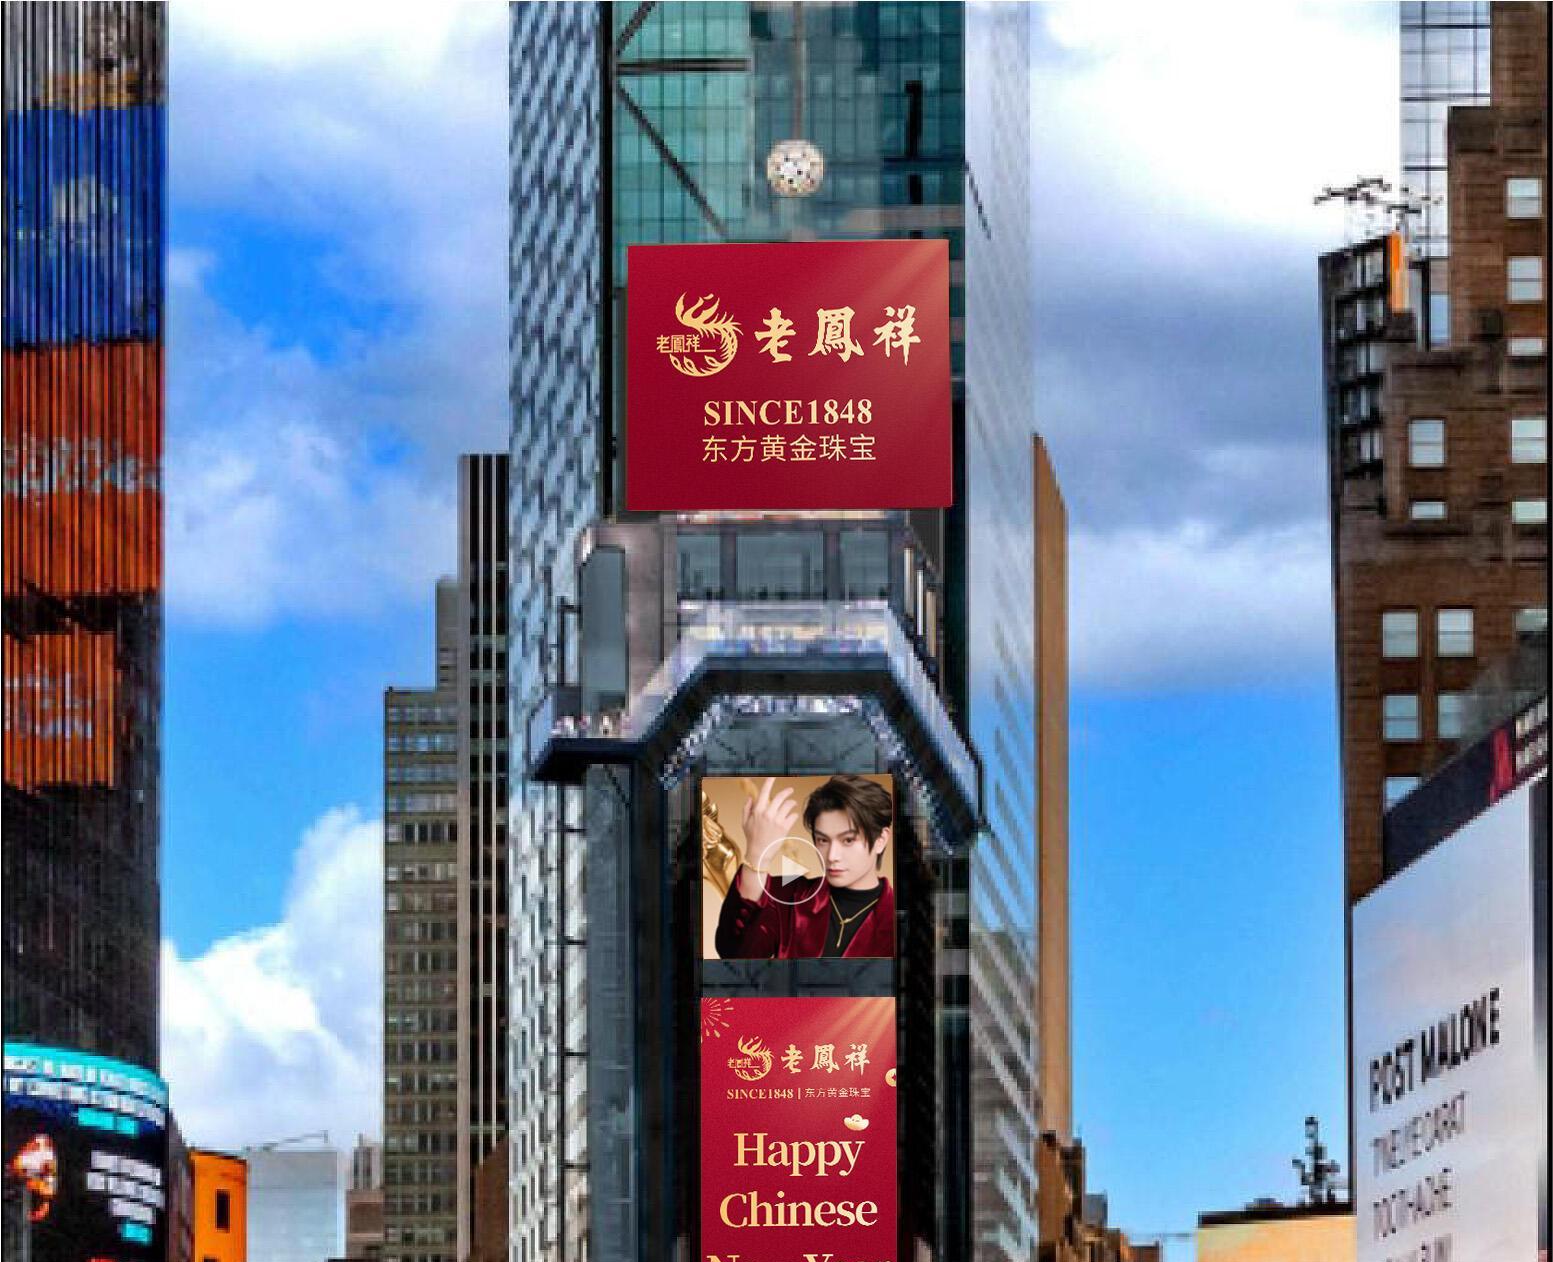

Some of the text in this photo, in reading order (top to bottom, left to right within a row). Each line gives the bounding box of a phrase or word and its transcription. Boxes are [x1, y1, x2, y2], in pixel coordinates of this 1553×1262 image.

[754, 304, 921, 366] 老鳳祥
[703, 398, 873, 426] SINCE1848
[702, 433, 876, 463] 东方黄金珠宝
[781, 1043, 871, 1076] 老鳳祥
[1369, 987, 1500, 1113] POST MALONE
[727, 1088, 794, 1100] SINCE1848
[804, 1087, 871, 1099] 东方黄金珠宝
[733, 1132, 865, 1177] Happy
[719, 1190, 878, 1228] Chinese
